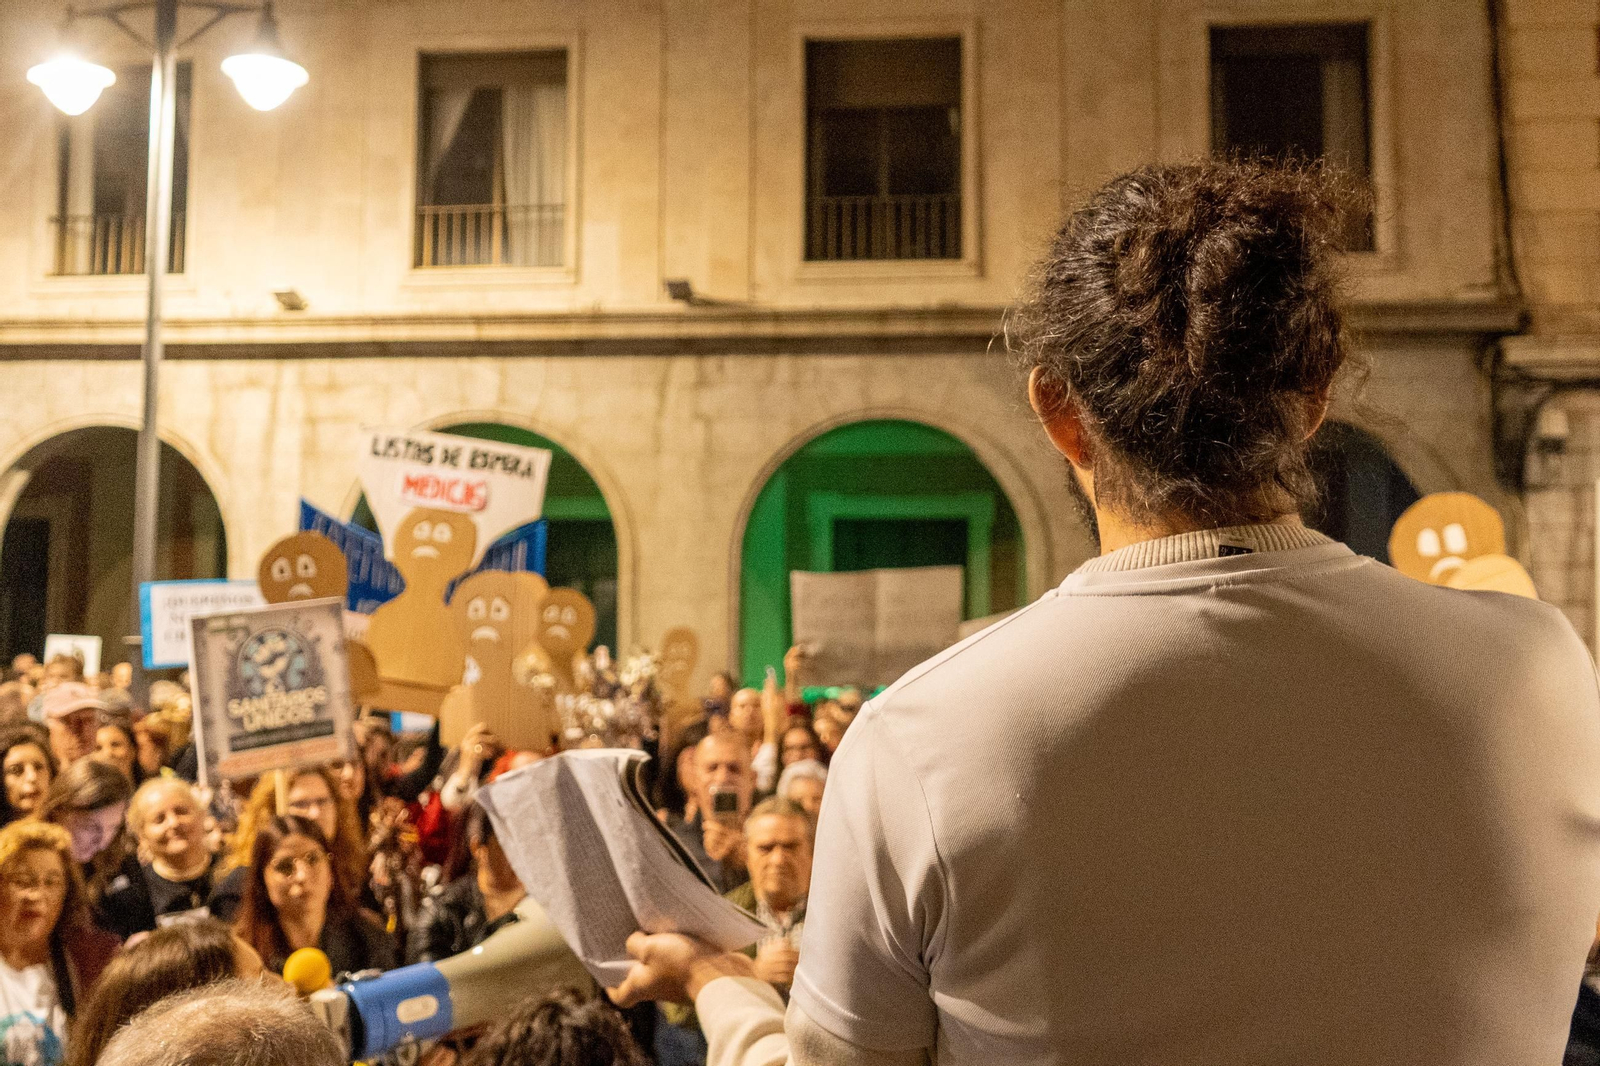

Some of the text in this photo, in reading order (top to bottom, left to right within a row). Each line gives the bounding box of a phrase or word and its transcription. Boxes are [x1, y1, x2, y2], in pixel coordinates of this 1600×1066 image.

[371, 436, 533, 478] LISTAS DE ESPERA
[403, 474, 487, 511] MEDICAS
